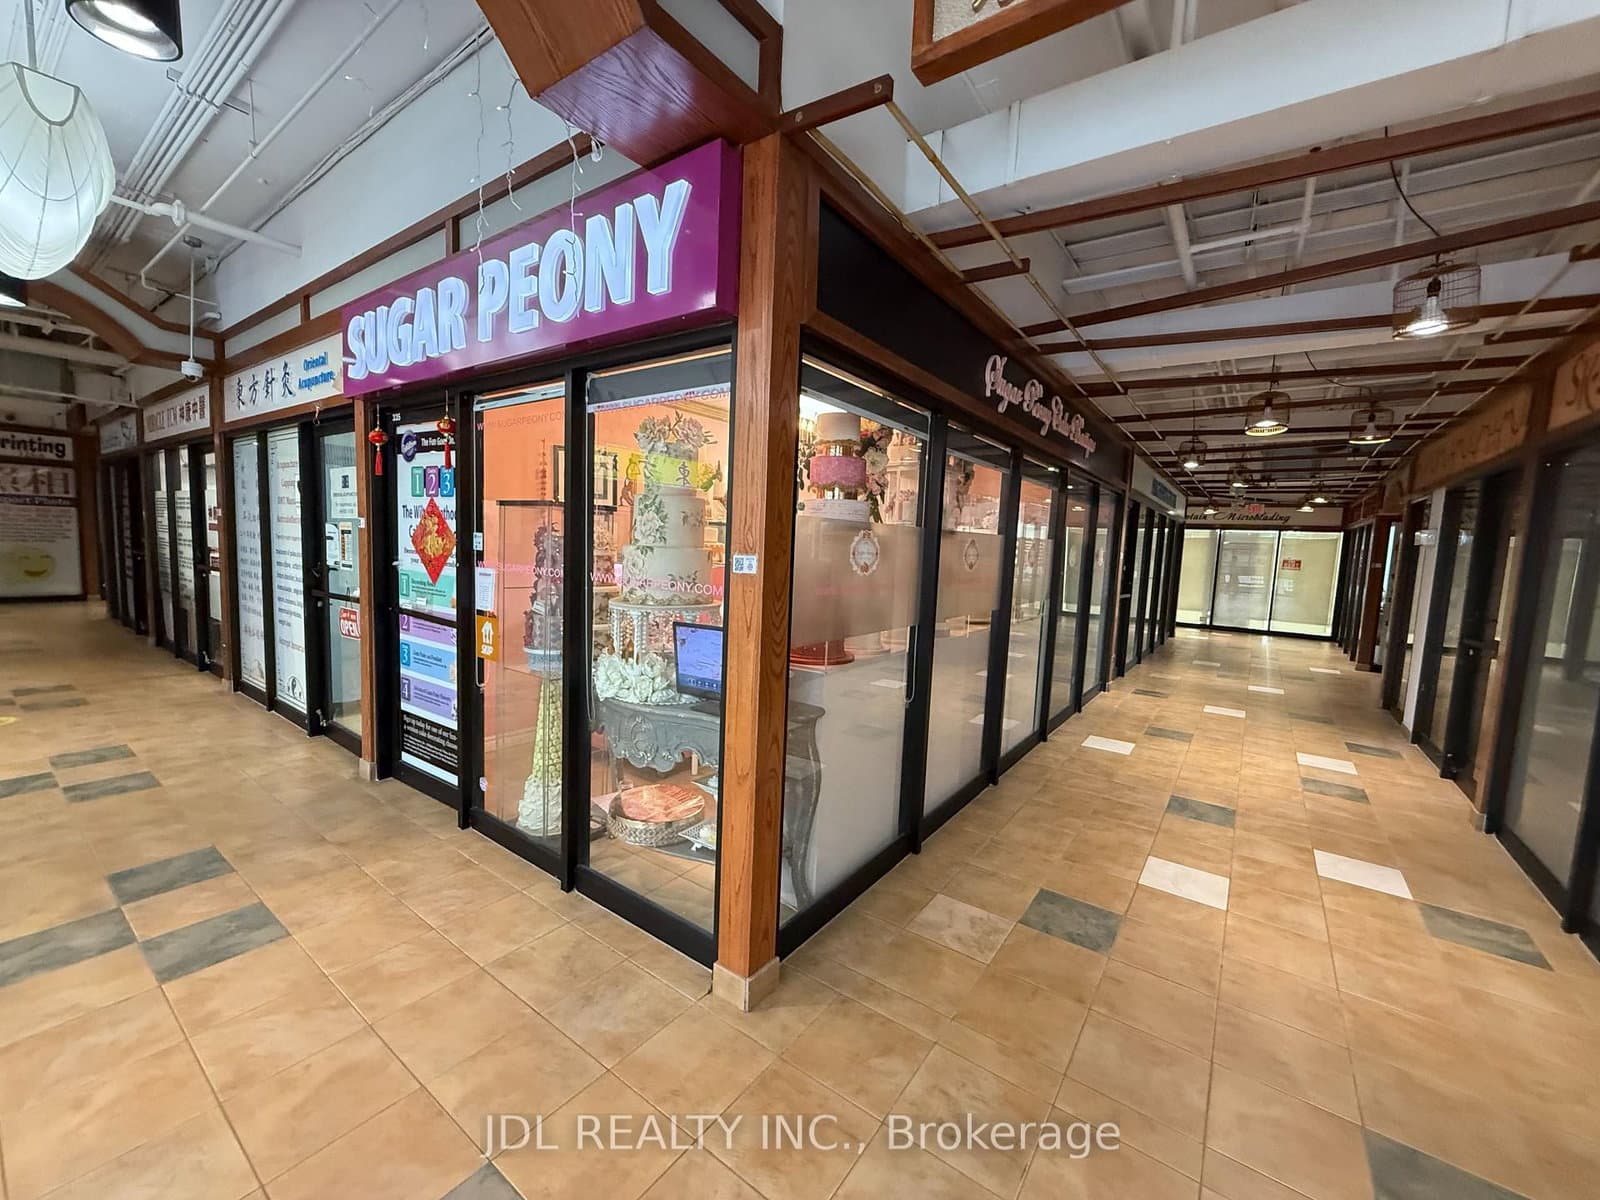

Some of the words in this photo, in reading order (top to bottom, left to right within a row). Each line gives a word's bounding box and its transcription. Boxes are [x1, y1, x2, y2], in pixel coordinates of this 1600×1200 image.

[347, 277, 469, 380] SUGAR
[477, 179, 693, 343] PEONY
[303, 352, 328, 371] Oriental
[298, 370, 336, 392] Acupuncture
[0, 434, 66, 458] rinting
[428, 473, 436, 495] 2
[443, 473, 451, 494] 3
[402, 505, 413, 519] The
